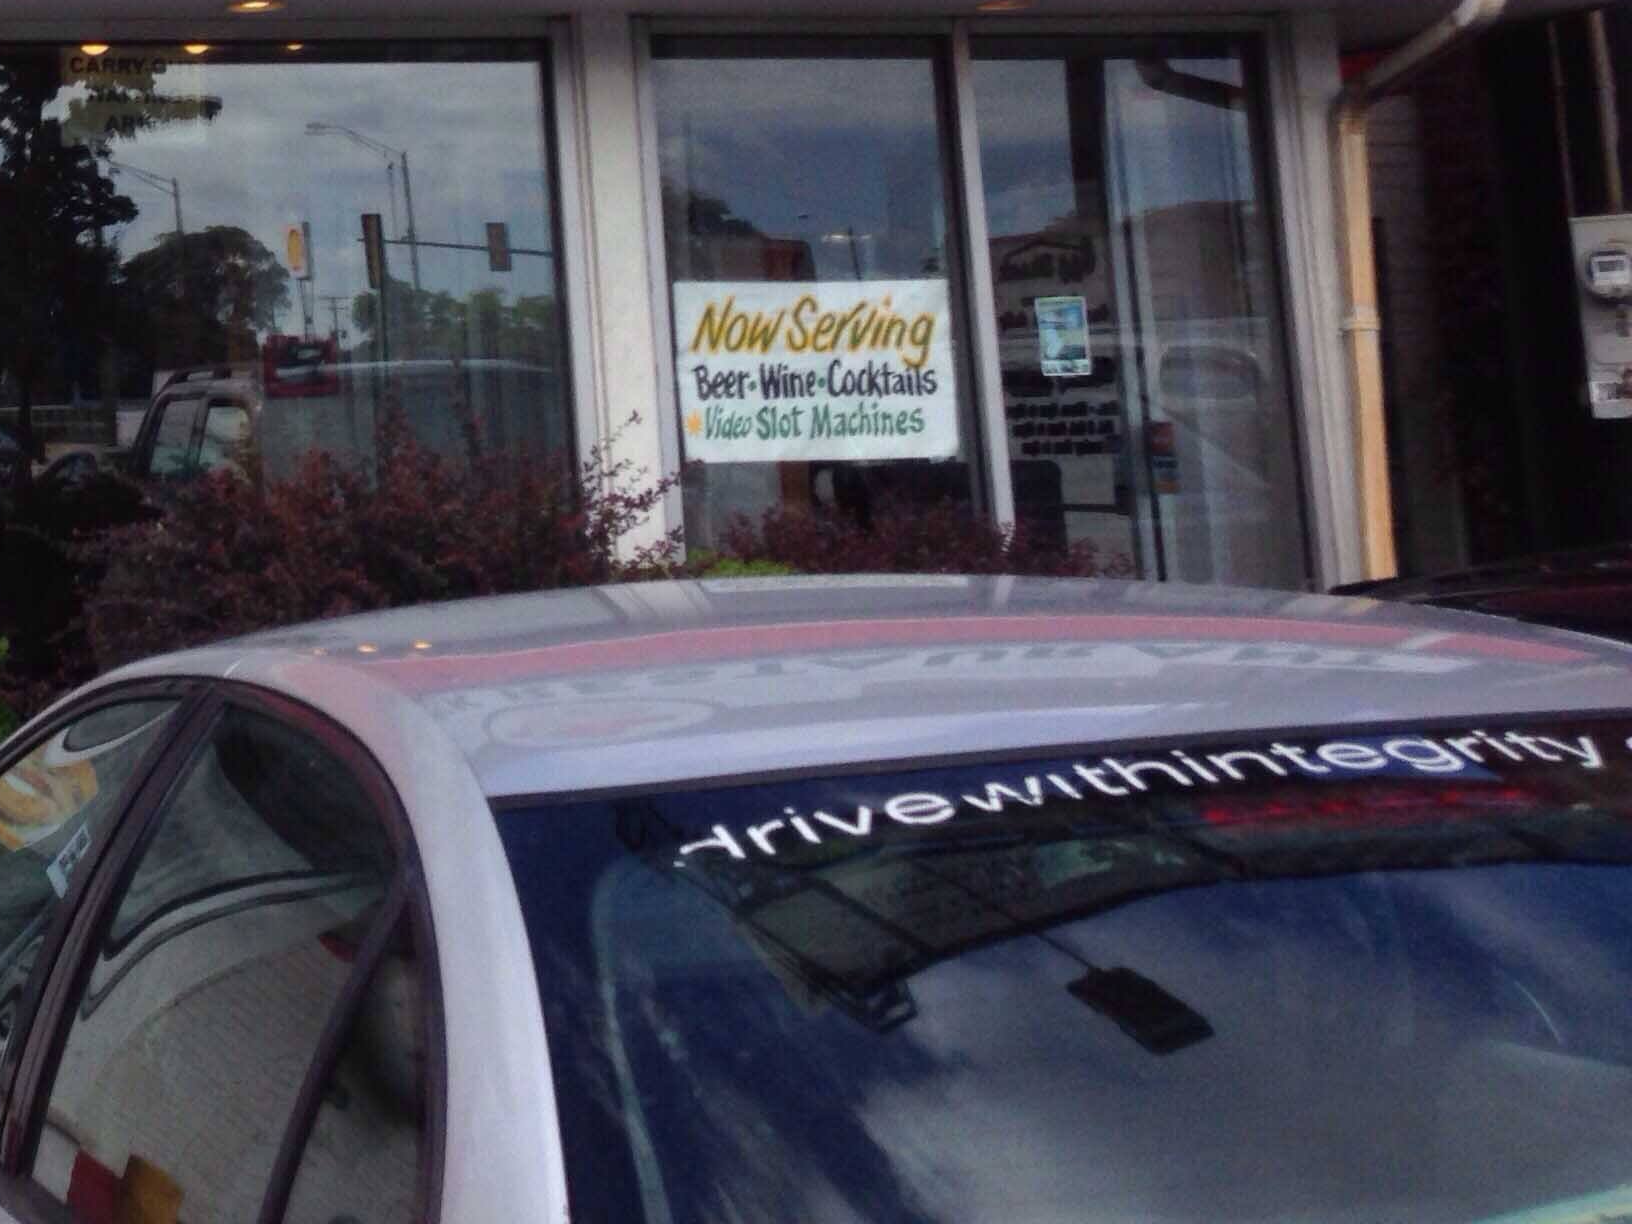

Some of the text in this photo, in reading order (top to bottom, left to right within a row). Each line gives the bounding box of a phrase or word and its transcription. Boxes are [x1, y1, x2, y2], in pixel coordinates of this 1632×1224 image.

[688, 294, 786, 355] Now
[785, 291, 937, 369] Serving
[693, 357, 938, 401] Beer Wine Cocktails
[704, 401, 926, 441] Video Slot Machines
